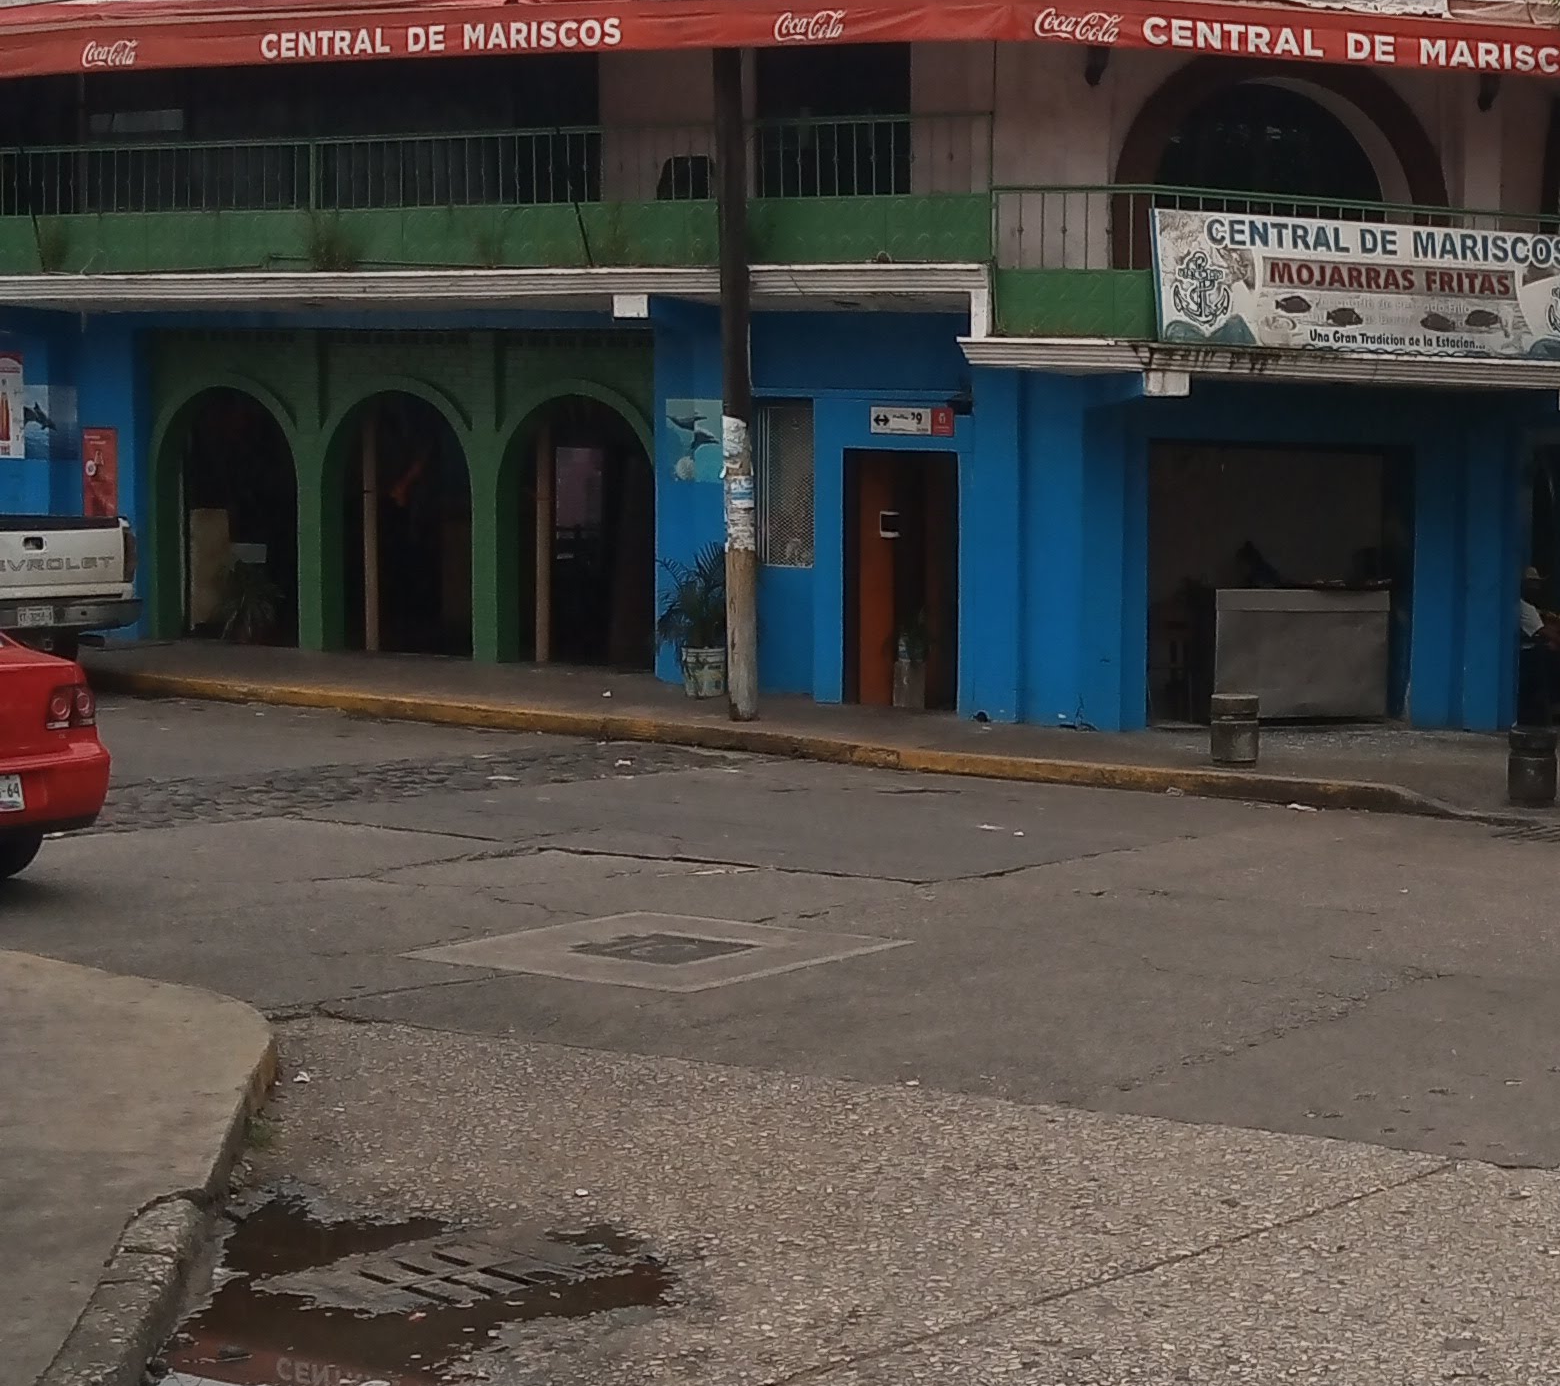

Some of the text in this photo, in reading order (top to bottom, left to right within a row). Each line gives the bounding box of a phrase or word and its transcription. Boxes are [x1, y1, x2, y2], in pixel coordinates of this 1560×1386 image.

[260, 18, 622, 59] CENTRAL DE MARISCOS
[771, 10, 847, 41] Coca-Cola
[1034, 7, 1124, 42] Coca-Cola
[1142, 16, 1324, 58] CENTRAL
[1346, 32, 1395, 62] DE
[82, 39, 138, 67] Coca-Cola
[1206, 218, 1350, 254] CENTRAL
[1359, 228, 1398, 255] DE
[1269, 261, 1511, 295] MOJARRAS FRITAS
[1309, 329, 1330, 344] Una
[1332, 330, 1358, 346] Gran
[1359, 333, 1406, 347] Tradicion
[1408, 335, 1421, 349] de
[1423, 335, 1433, 349] la
